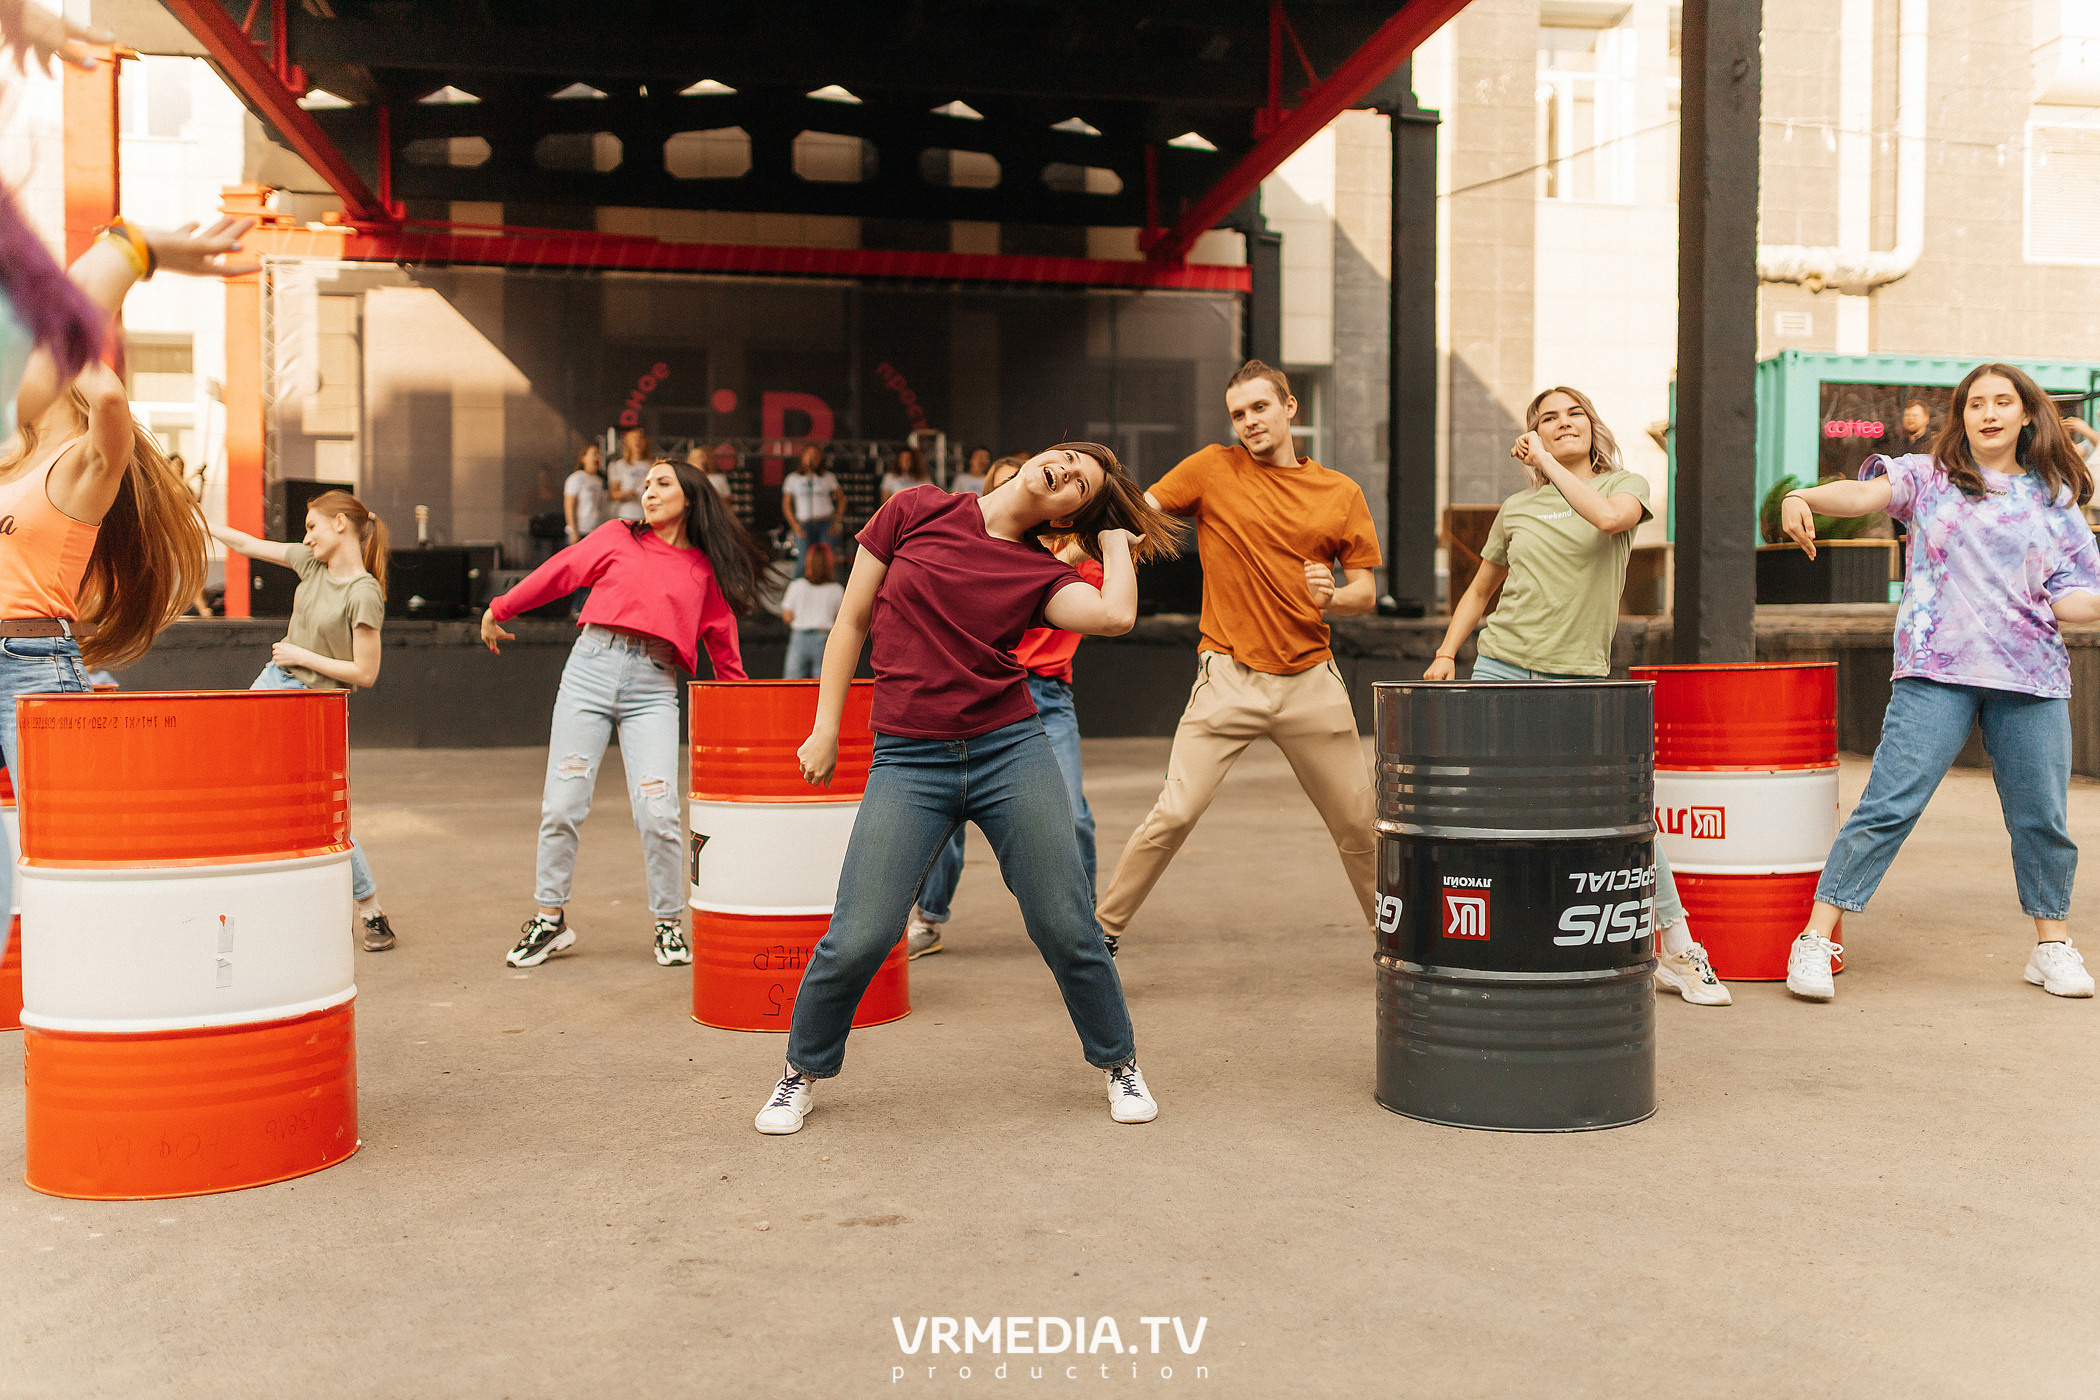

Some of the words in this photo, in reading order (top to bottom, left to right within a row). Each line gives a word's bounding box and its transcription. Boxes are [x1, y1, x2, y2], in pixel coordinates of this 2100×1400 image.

[1824, 418, 1884, 438] coffee
[1443, 875, 1493, 889] ЛУКОЙЛ
[1568, 863, 1655, 894] SPECIAL
[1553, 896, 1655, 947] ESIS
